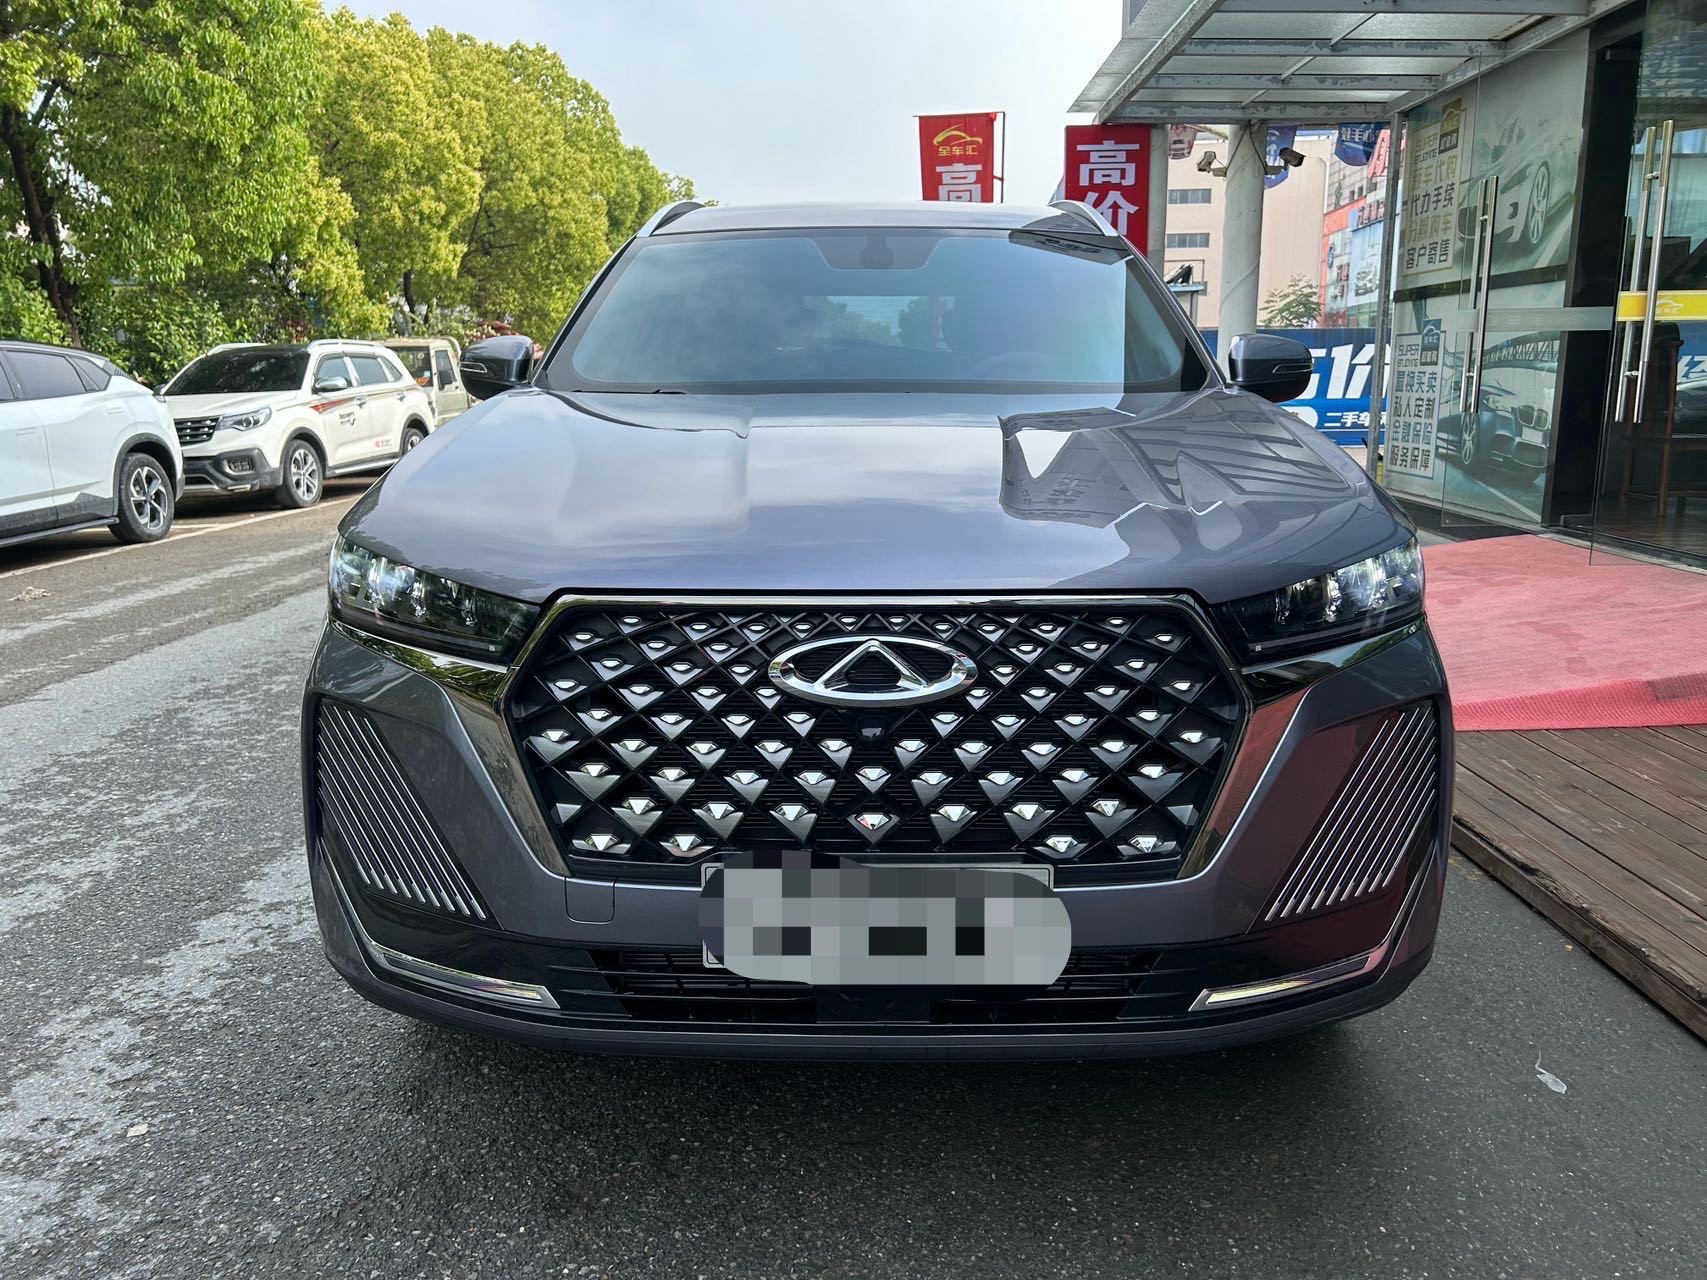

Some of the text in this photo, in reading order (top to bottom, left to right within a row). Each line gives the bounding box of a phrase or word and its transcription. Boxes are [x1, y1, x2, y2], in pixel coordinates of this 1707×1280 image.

[938, 145, 978, 156] 全车汇
[936, 163, 983, 202] 高
[1076, 140, 1140, 236] 高价
[1406, 239, 1450, 269] 客户寄售
[1395, 370, 1437, 393] 置换买卖
[1393, 396, 1435, 420] 私人定制
[1390, 445, 1430, 471] 服务保障
